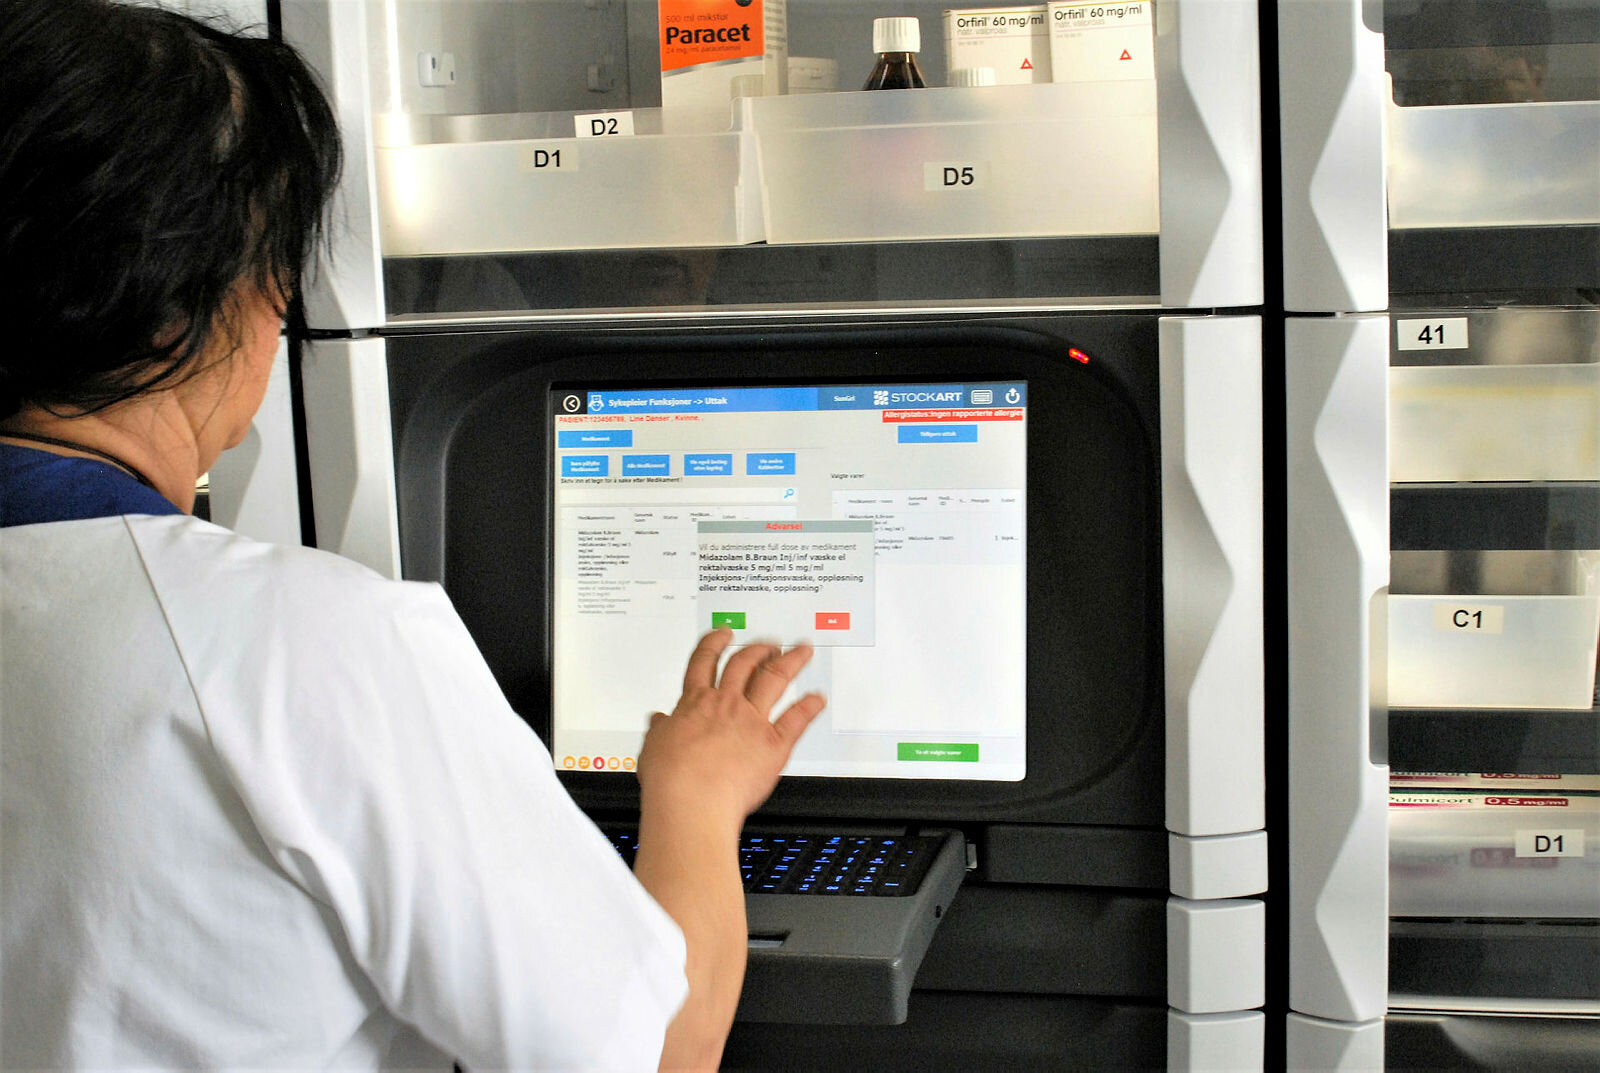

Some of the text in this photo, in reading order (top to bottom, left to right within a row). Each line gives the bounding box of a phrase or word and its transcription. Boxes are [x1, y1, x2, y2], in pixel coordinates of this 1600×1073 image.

[1090, 8, 1104, 17] 60
[1106, 4, 1142, 18] mg/ml
[666, 15, 679, 23] 500
[992, 16, 1006, 26] 60
[1008, 14, 1044, 28] mg/ml
[666, 24, 750, 45] Paracet
[591, 118, 619, 136] D2
[534, 149, 561, 168] D1
[943, 167, 974, 186] D5
[1418, 324, 1446, 345] 41
[704, 397, 728, 405] Uttak
[891, 392, 963, 402] STOCKART
[765, 522, 803, 530] Advarsel
[781, 543, 799, 551] dose
[699, 553, 743, 561] Midazolam
[745, 553, 778, 561] B.Braun
[751, 563, 756, 571] 5
[758, 563, 786, 572] mg/ml
[788, 563, 793, 571] 5
[795, 563, 824, 572] mg/ml
[699, 584, 717, 592] eller
[1453, 609, 1482, 628] C1
[1487, 797, 1520, 805] 0.5
[1523, 799, 1566, 807] mg/ml
[1535, 835, 1563, 853] D1
